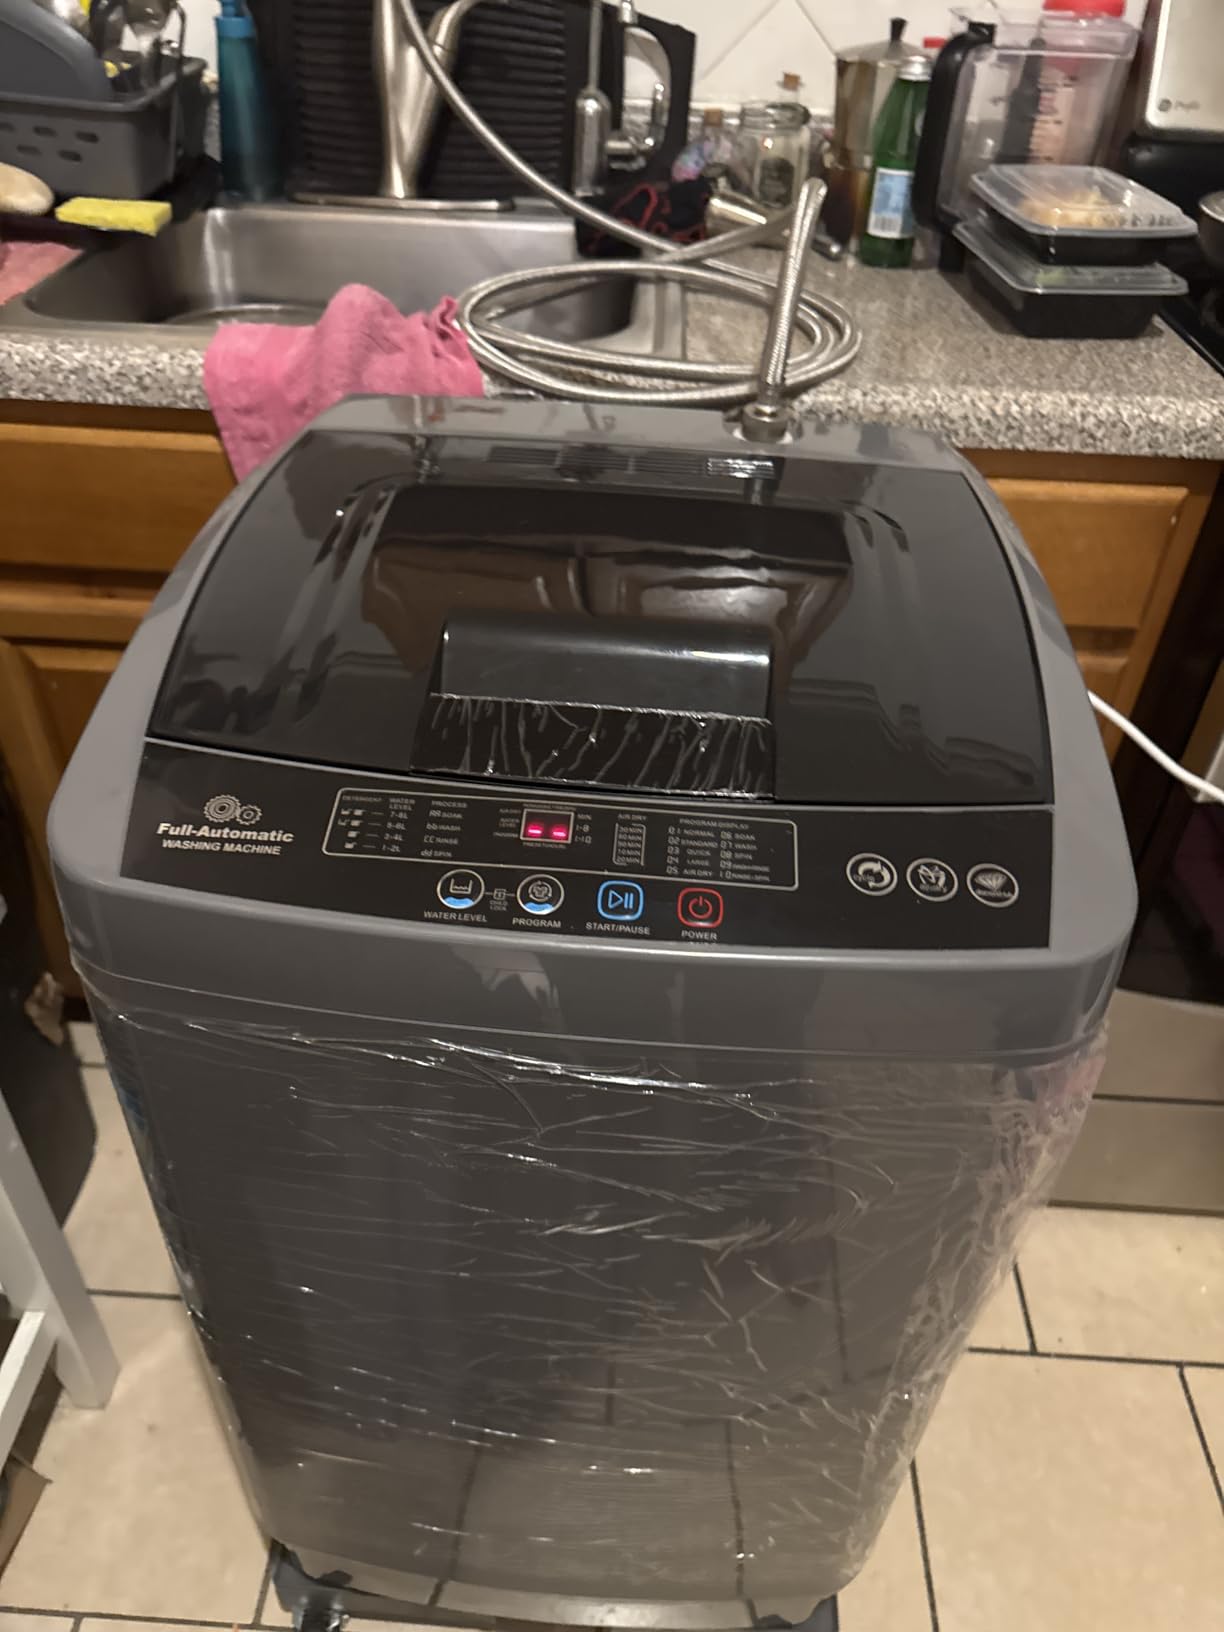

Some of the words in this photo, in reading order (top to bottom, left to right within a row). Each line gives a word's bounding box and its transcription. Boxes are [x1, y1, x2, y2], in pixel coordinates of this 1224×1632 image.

[157, 823, 294, 842] Full-Automatic
[162, 839, 221, 851] WASHING
[222, 842, 281, 855] MACHINE
[423, 911, 457, 920] WATER
[458, 913, 488, 923] LEVEL
[512, 917, 562, 928] PROGRAM
[585, 921, 650, 935] START/PAUSE
[681, 929, 717, 940] POWER
